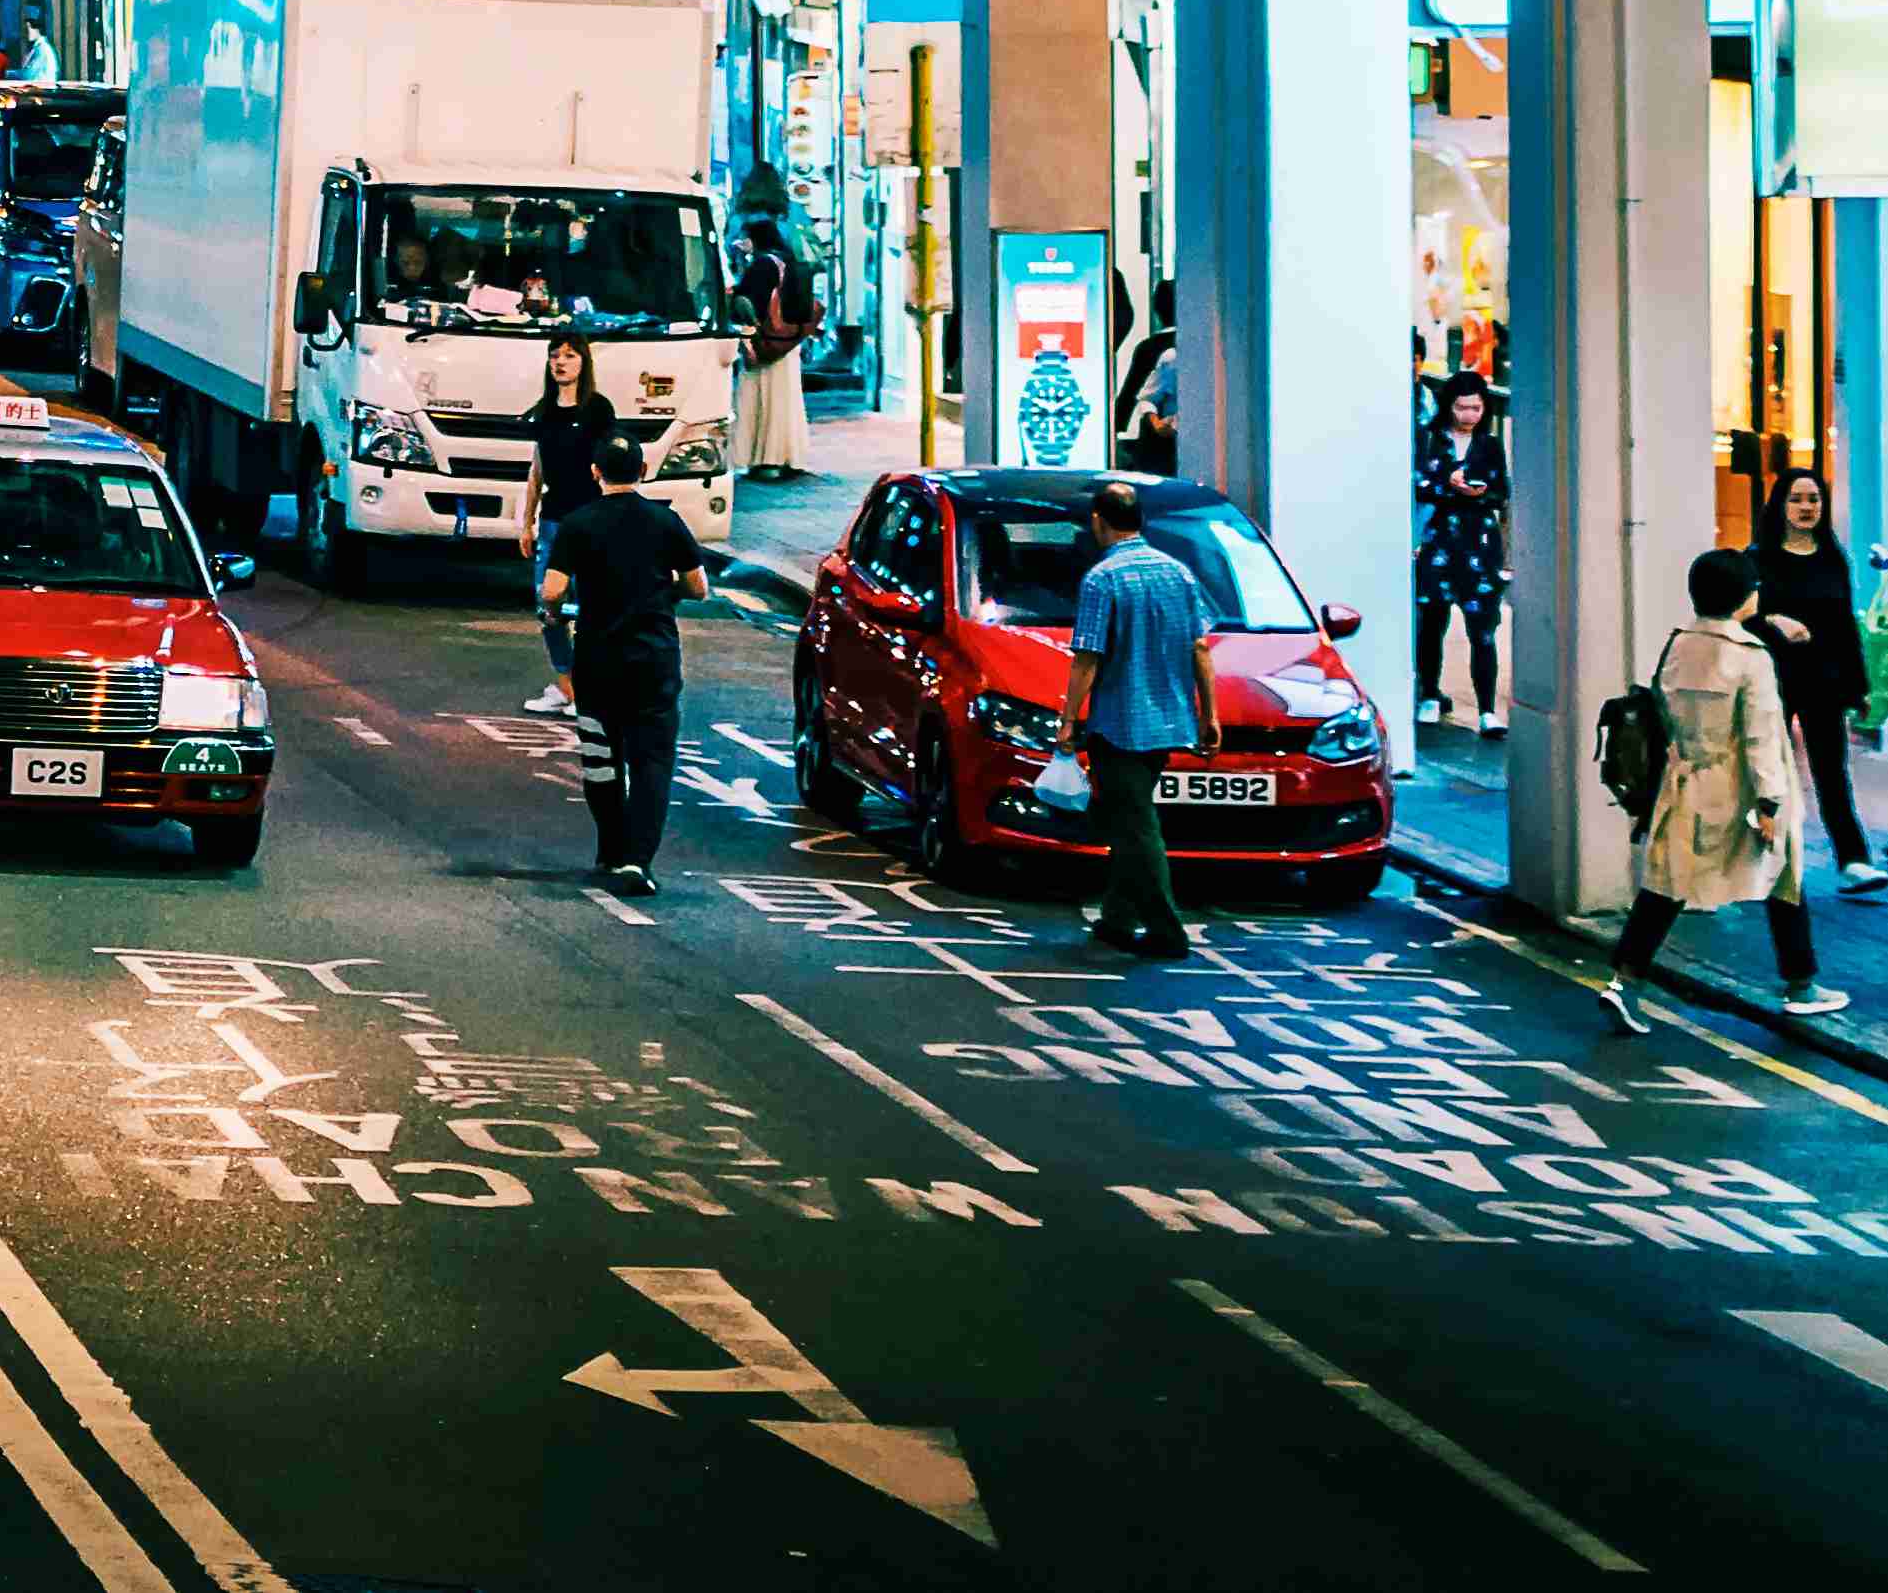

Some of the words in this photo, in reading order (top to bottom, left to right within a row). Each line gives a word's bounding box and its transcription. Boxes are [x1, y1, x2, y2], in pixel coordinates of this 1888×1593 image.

[5, 402, 41, 421] 的士
[27, 759, 88, 785] C2S
[179, 762, 226, 773] SEATS
[195, 747, 210, 763] 4
[1187, 775, 1269, 802] 5892
[995, 1004, 1520, 1056] ROAD
[921, 1043, 1770, 1111] FLEMING
[116, 1107, 783, 1166] ROAD
[1210, 1092, 1610, 1149] AND
[57, 1153, 535, 1209] CHAI
[1240, 1145, 1821, 1204] ROAD
